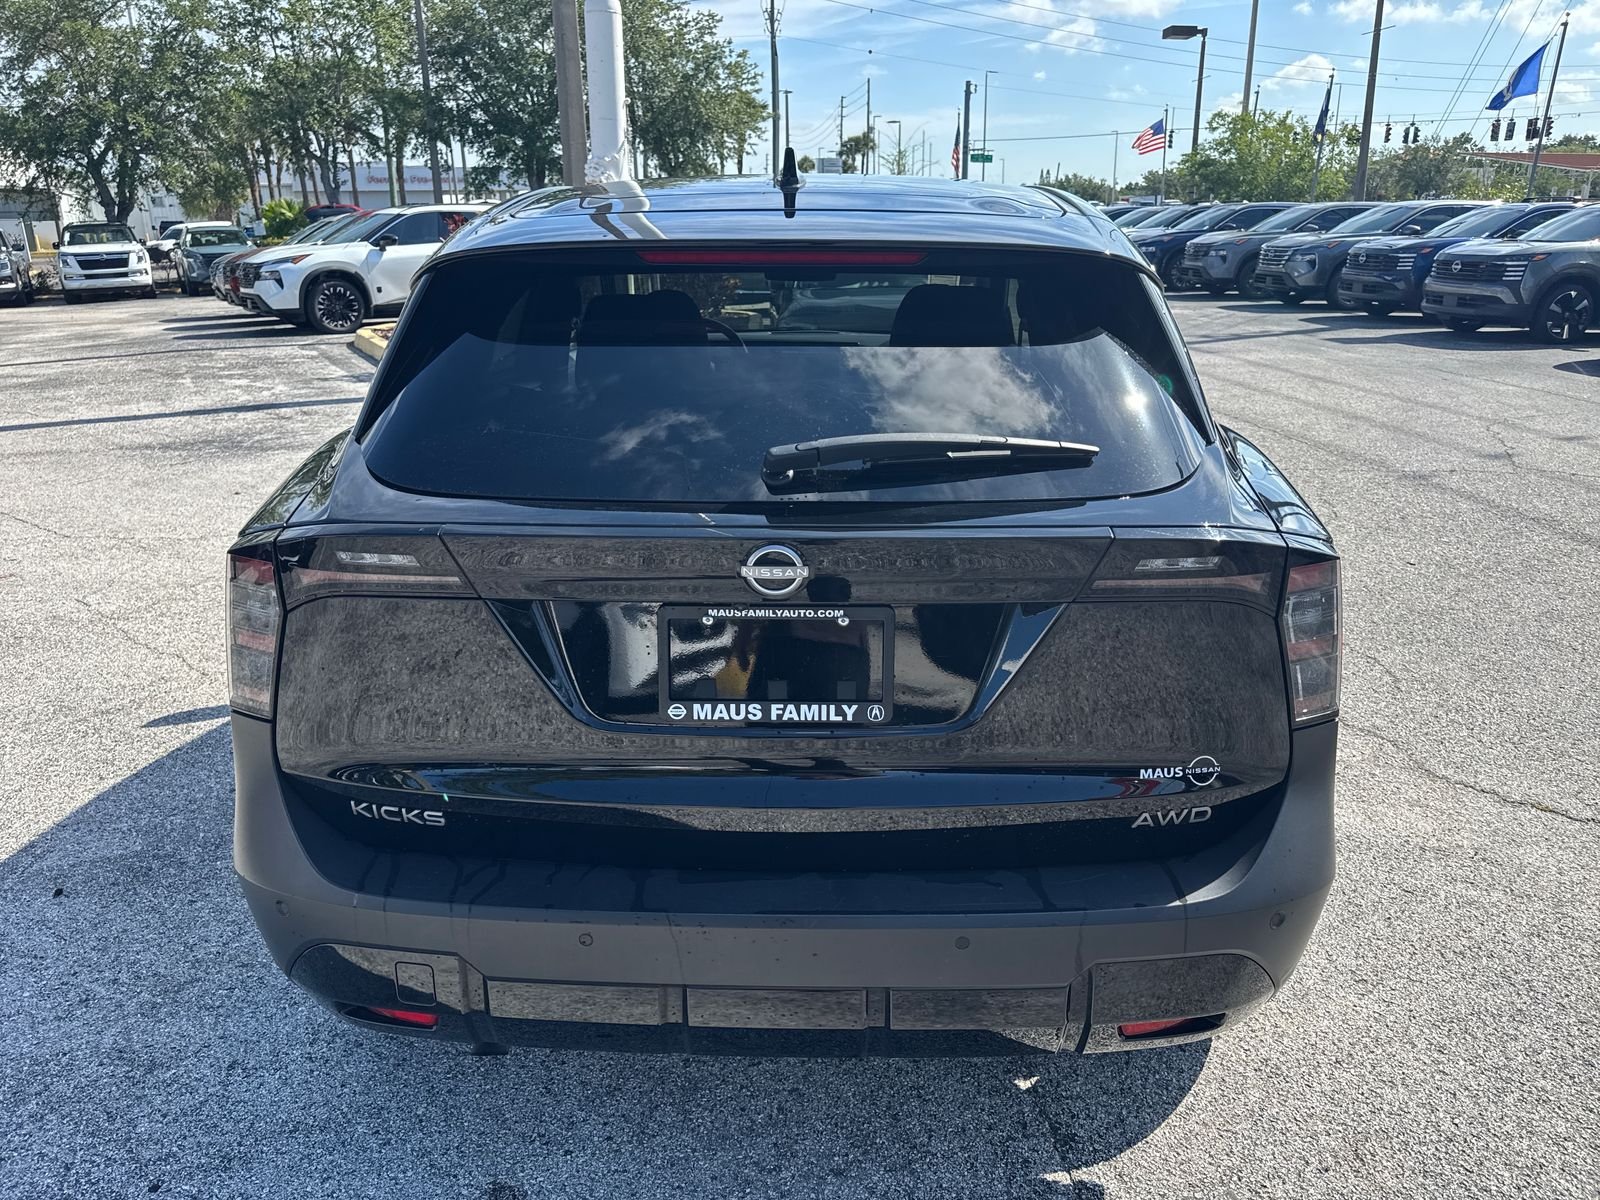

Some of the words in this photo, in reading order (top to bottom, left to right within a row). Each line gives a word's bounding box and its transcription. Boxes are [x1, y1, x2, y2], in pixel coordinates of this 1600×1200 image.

[742, 567, 808, 577] NISSAN
[708, 608, 844, 618] MAUSFAMILYAUTO.COM
[693, 703, 763, 721] MAUS
[771, 704, 858, 722] FAMILY
[1139, 767, 1183, 779] MAUS
[1185, 766, 1221, 774] NISSAN
[350, 800, 446, 826] KICKS
[1131, 806, 1212, 829] AWD
